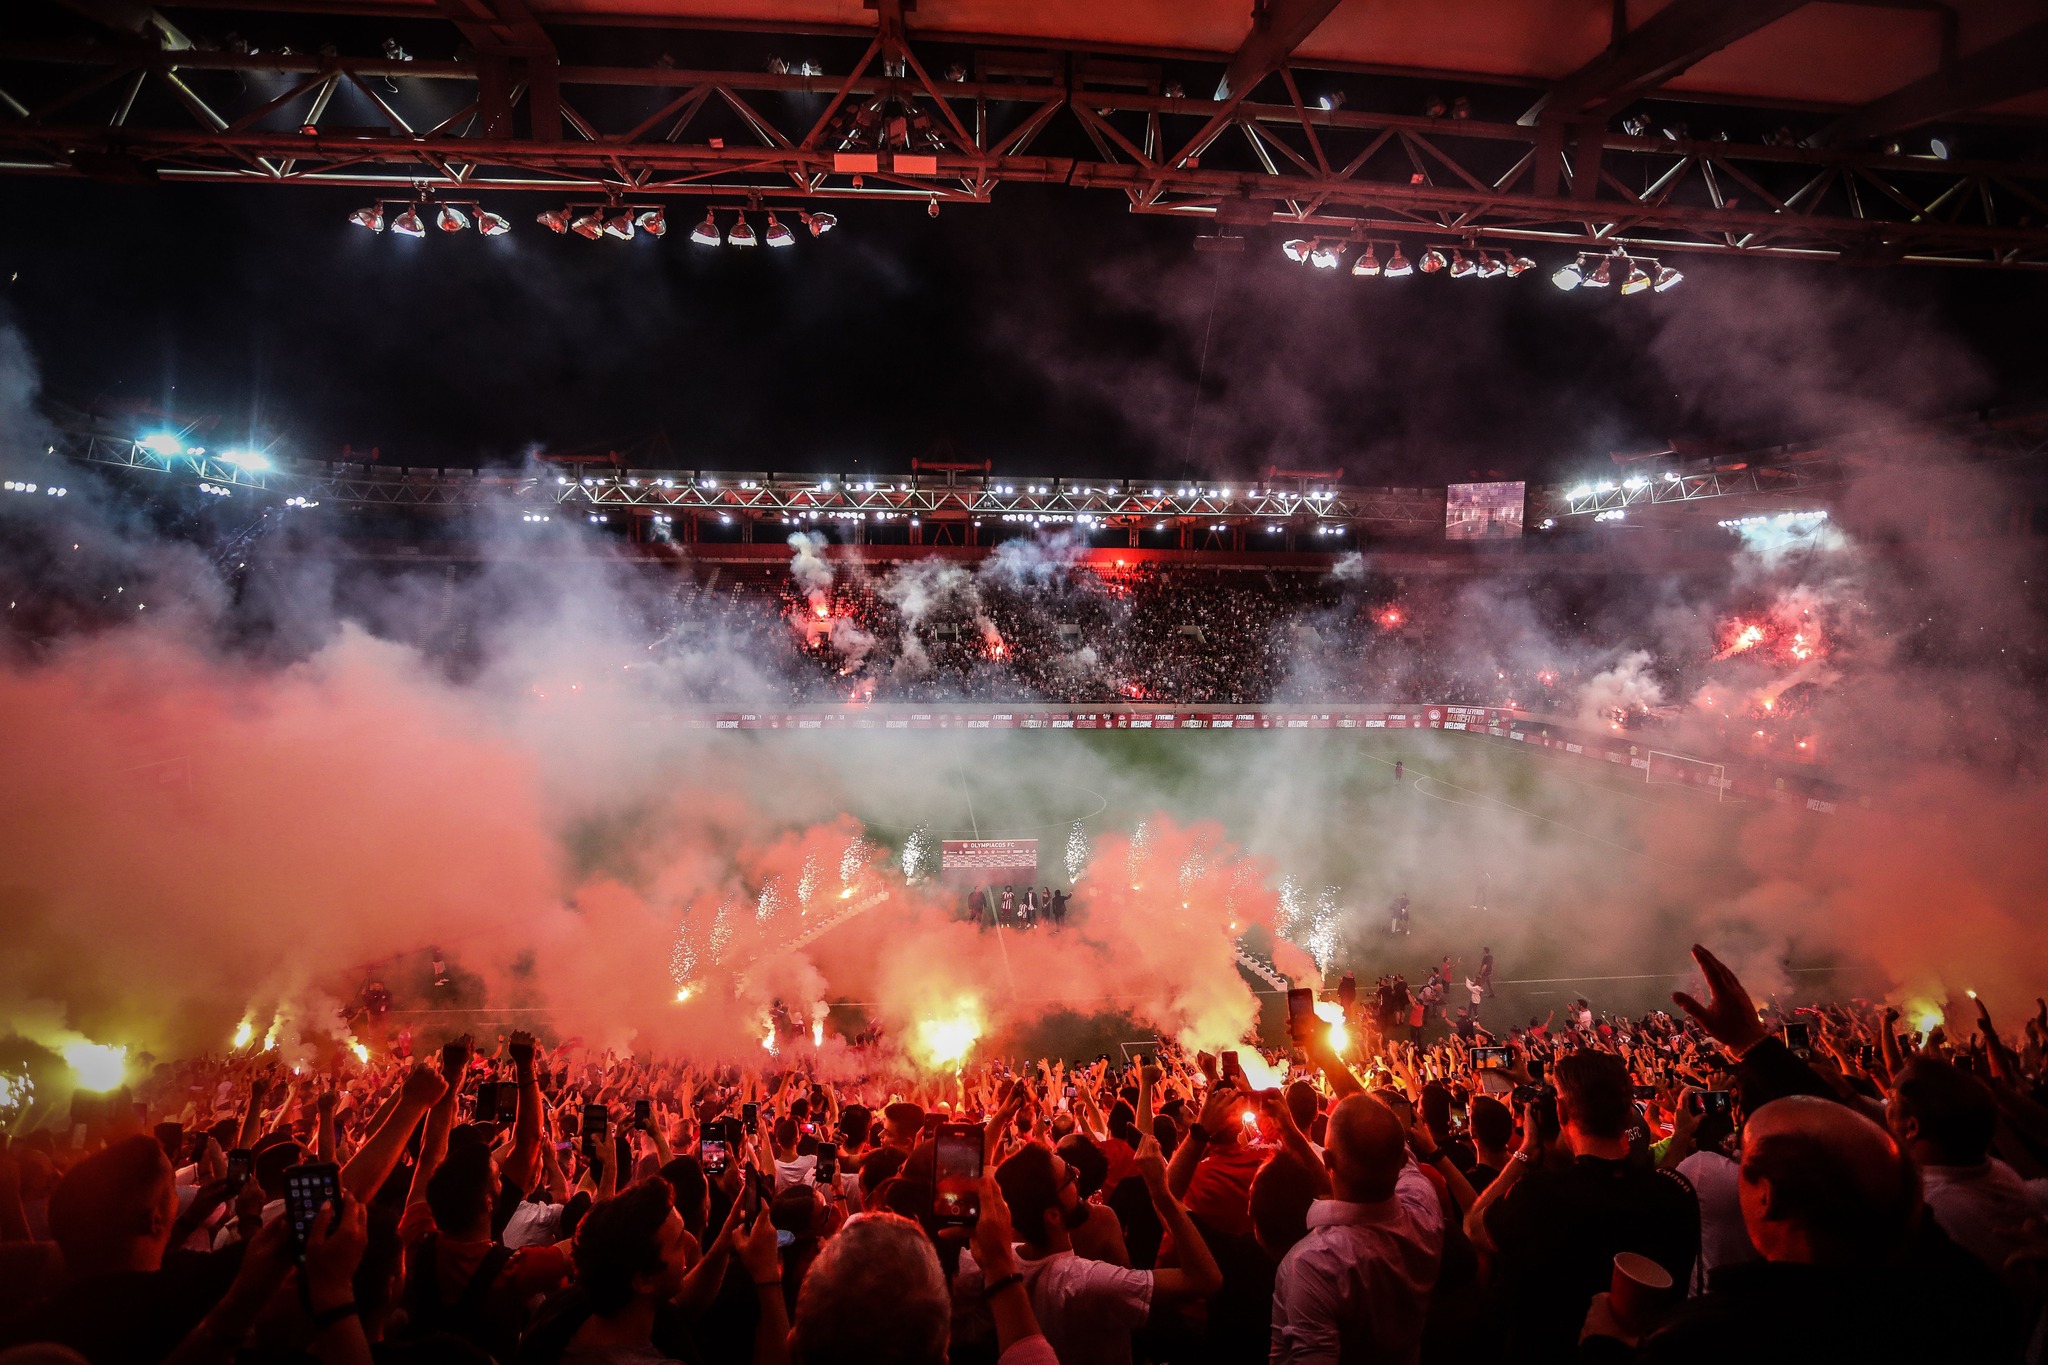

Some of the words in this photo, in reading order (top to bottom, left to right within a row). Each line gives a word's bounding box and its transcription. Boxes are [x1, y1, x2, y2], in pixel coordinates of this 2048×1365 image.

[1446, 714, 1476, 723] MARCELO
[716, 720, 739, 729] WELCOME
[799, 720, 822, 729] WELCOME
[886, 720, 909, 729] WELCOME
[968, 720, 990, 729] WELCOME
[1052, 720, 1074, 728] WELCOME
[1130, 720, 1152, 728] WELCOME
[1212, 720, 1234, 728] WELCOME
[1287, 720, 1309, 728] WELCOME
[1365, 720, 1386, 728] WELCOME
[1444, 721, 1466, 731] WELCOME
